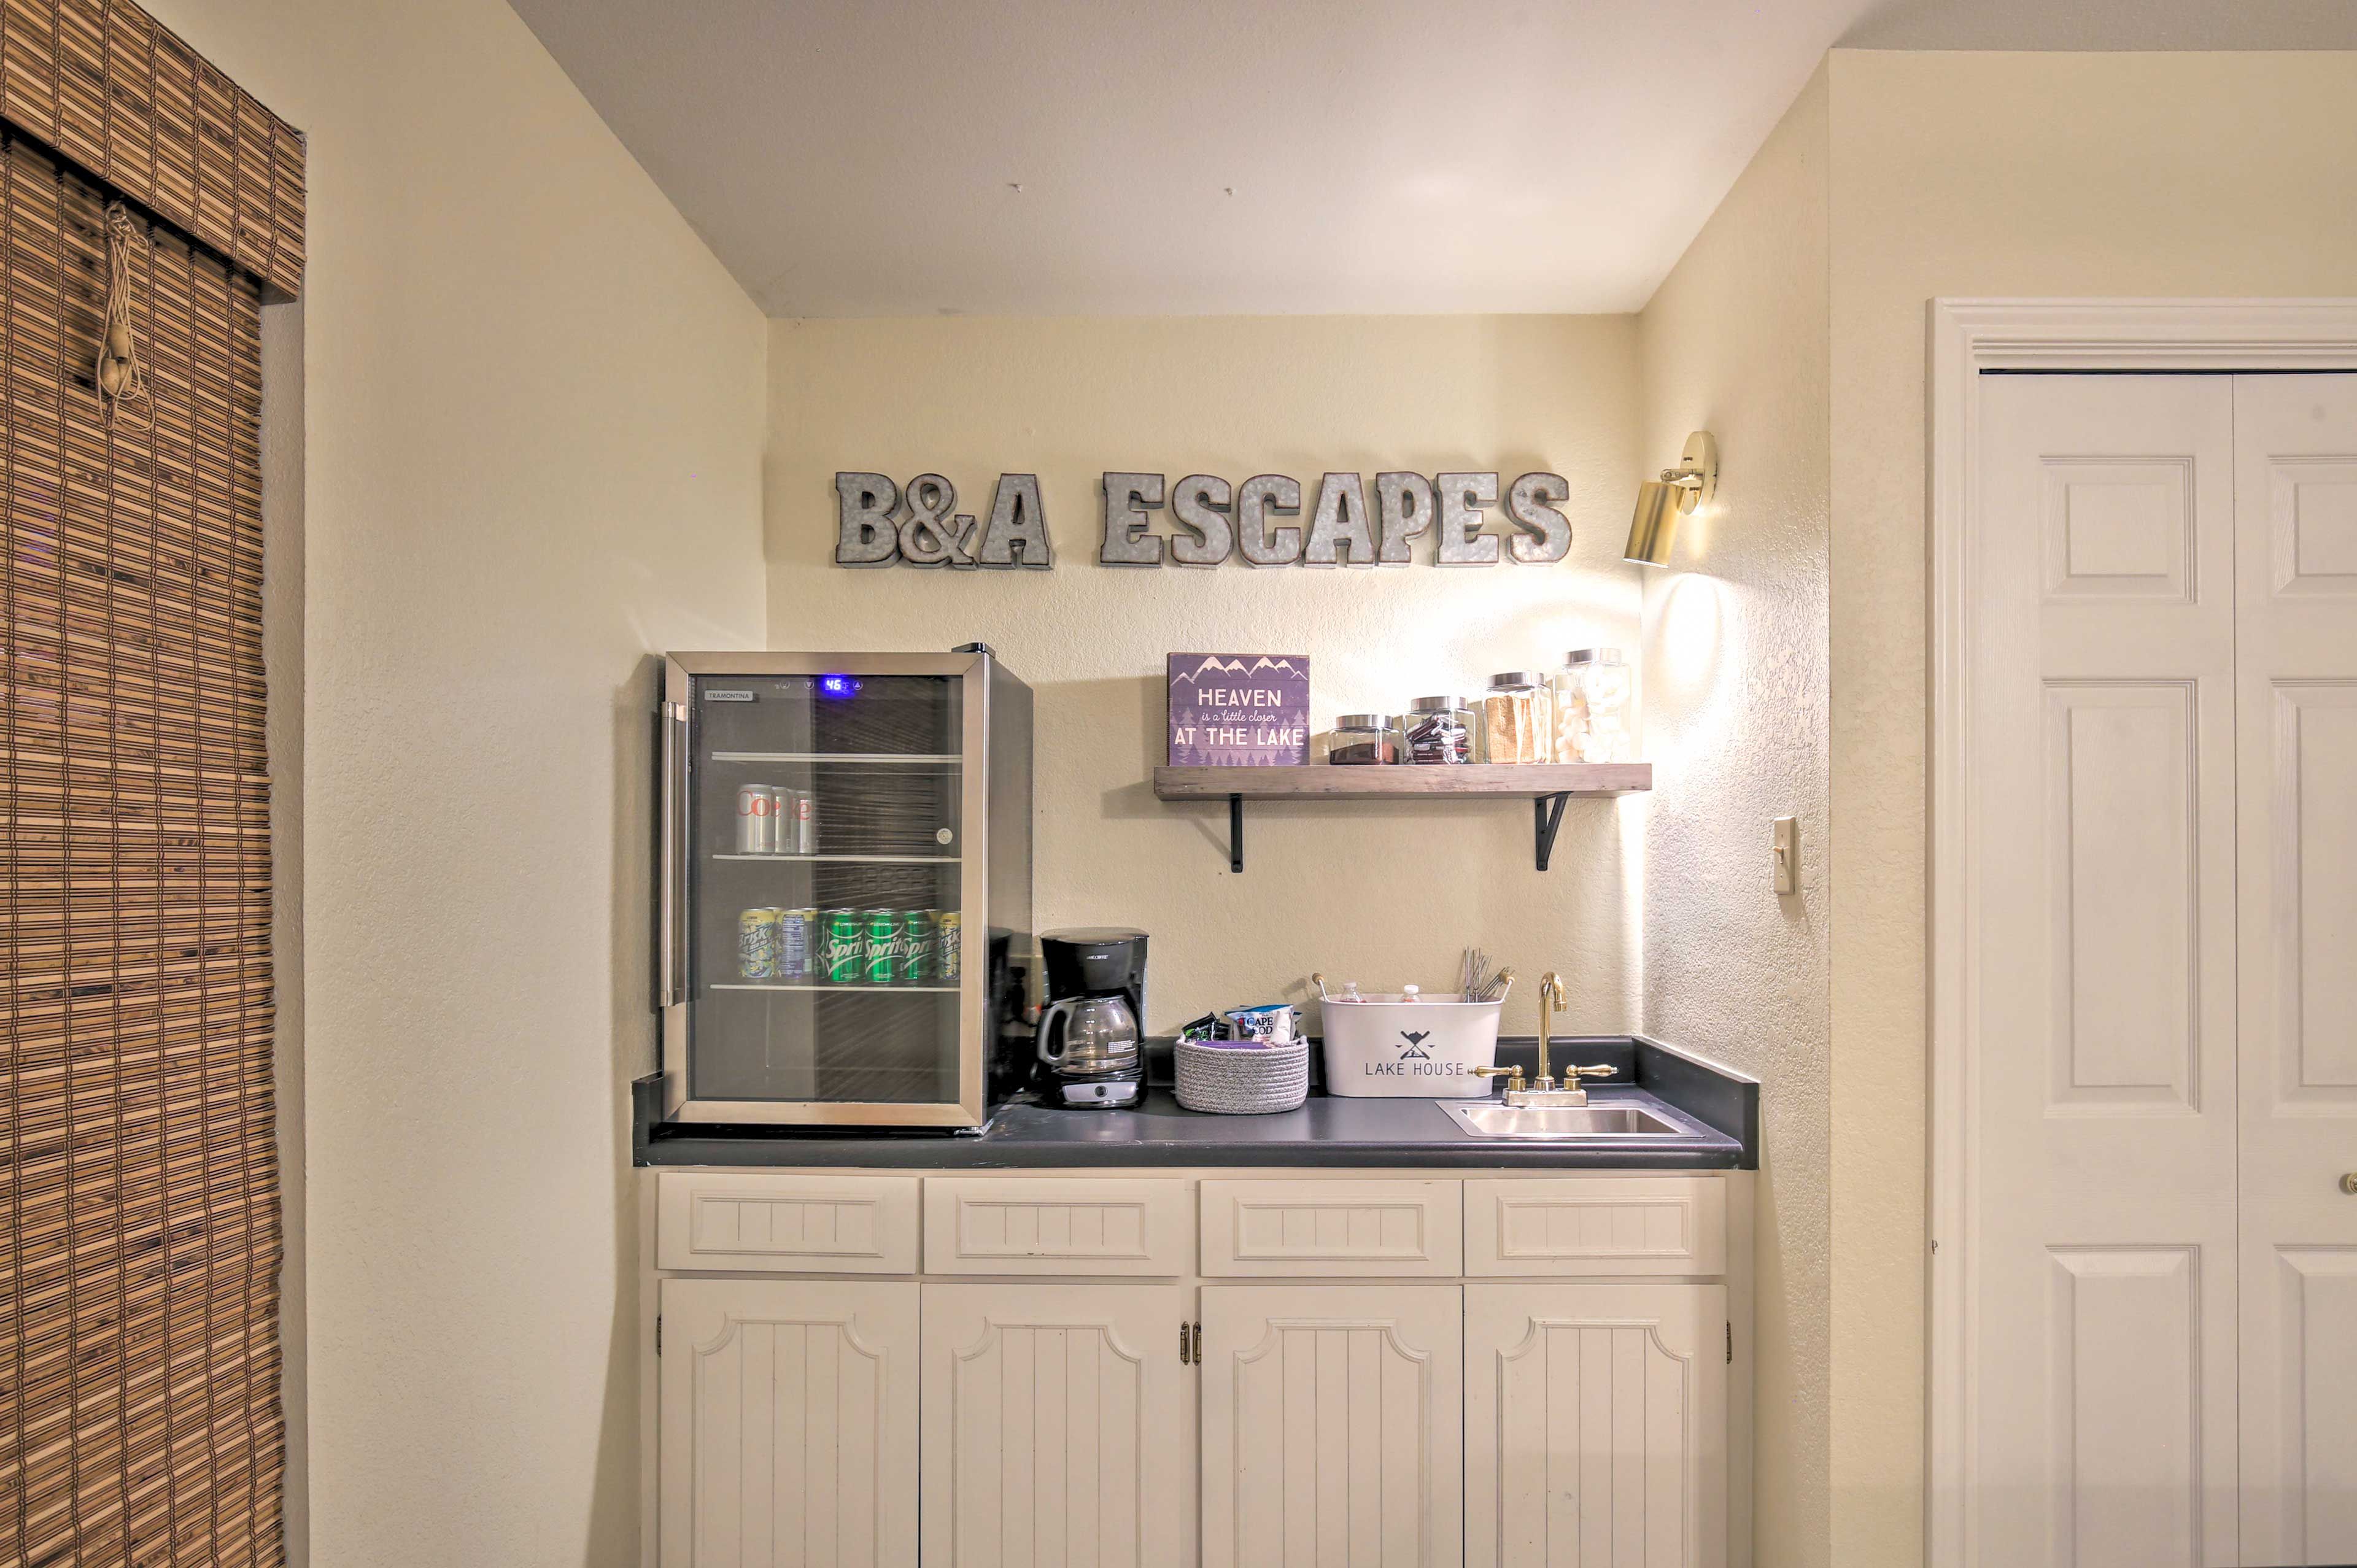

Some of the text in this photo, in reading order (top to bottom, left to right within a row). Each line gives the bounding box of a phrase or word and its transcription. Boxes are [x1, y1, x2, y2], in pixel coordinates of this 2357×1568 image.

[835, 472, 1573, 570] B&A ESCAPES
[826, 679, 841, 690] 46
[1198, 689, 1281, 707] HEAVEN
[1202, 712, 1210, 721] is
[1221, 709, 1247, 721] little
[1248, 709, 1277, 722] closer
[1174, 727, 1304, 746] AT THE LAKE
[1247, 1017, 1273, 1026] CAPE
[1252, 1025, 1273, 1035] COD
[1366, 1062, 1463, 1075] LAKE HOUSE
